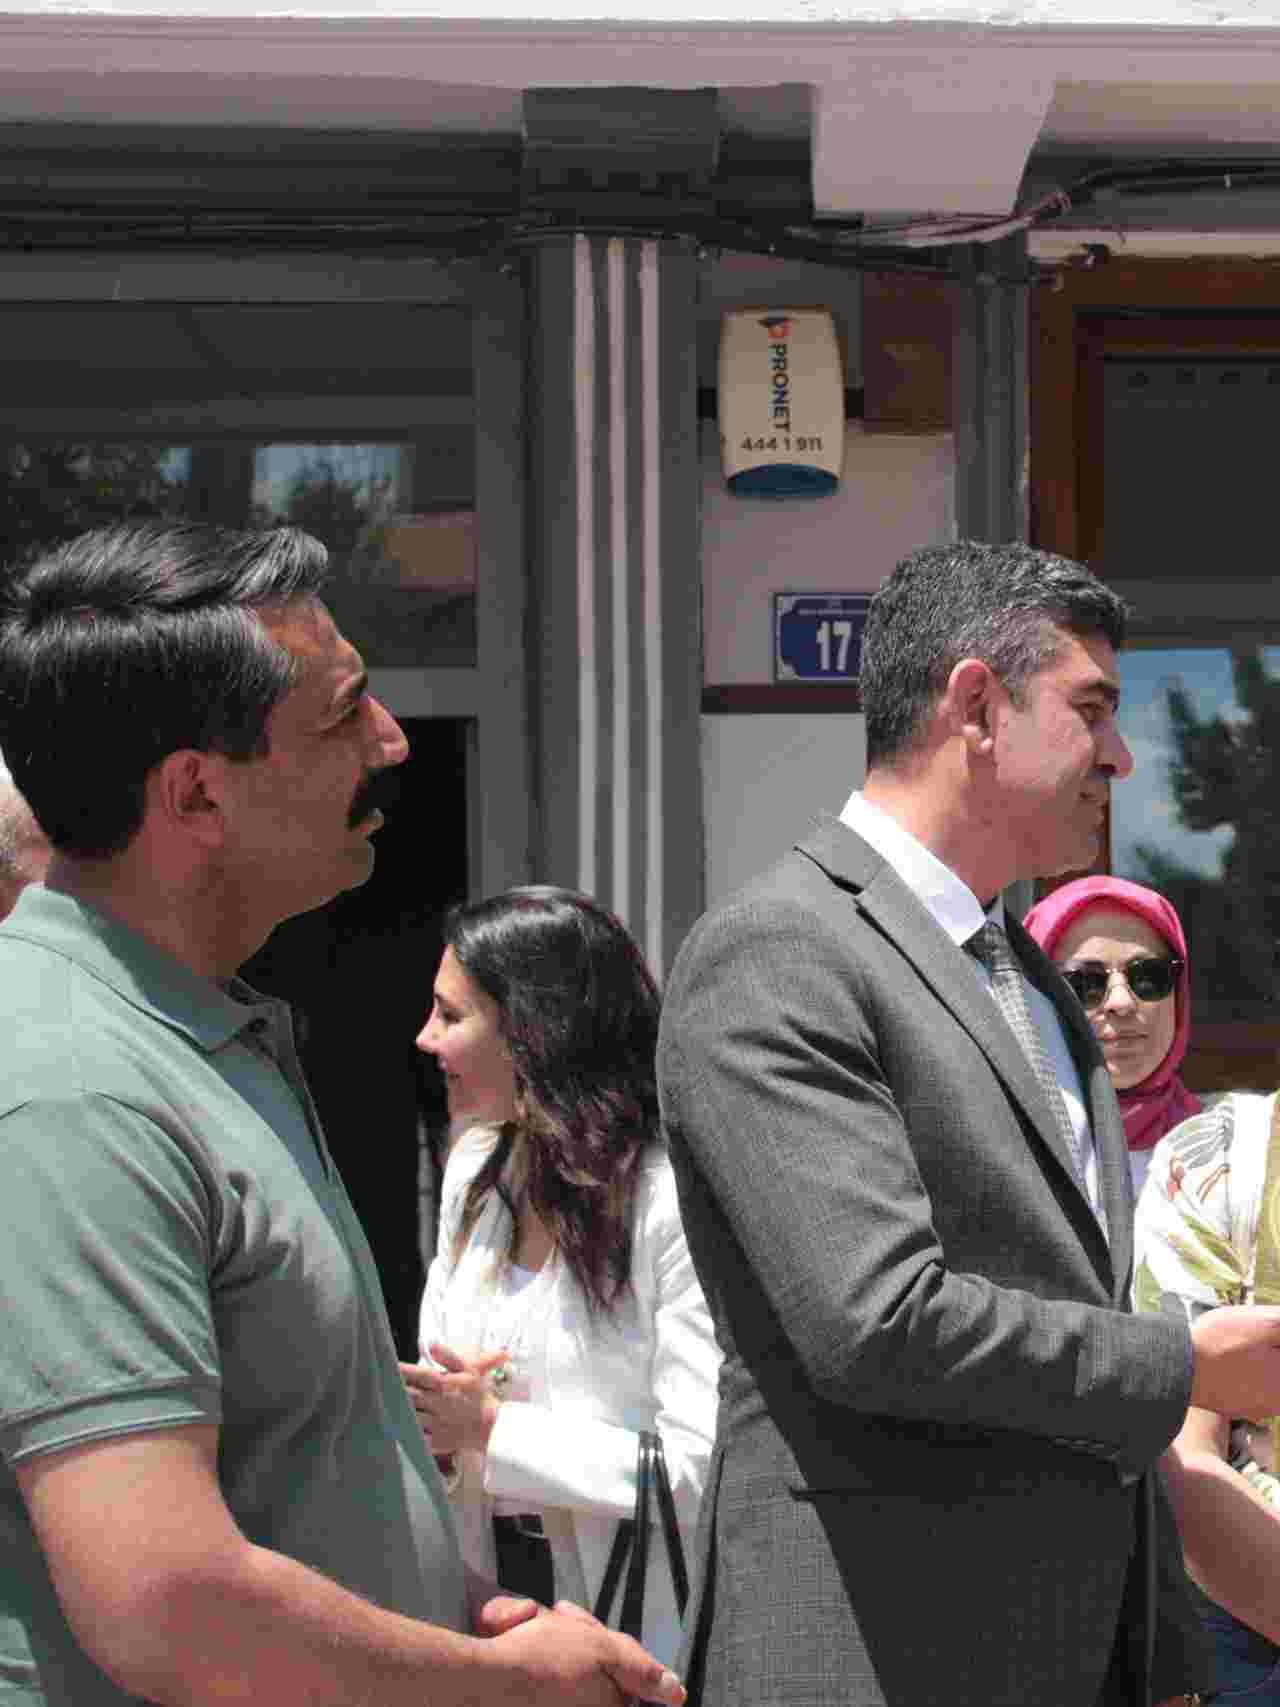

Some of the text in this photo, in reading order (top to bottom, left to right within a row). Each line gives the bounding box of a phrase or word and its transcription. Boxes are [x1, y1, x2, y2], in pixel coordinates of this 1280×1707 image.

[771, 343, 790, 432] PRONET
[741, 436, 778, 451] 444
[816, 621, 851, 671] 17
